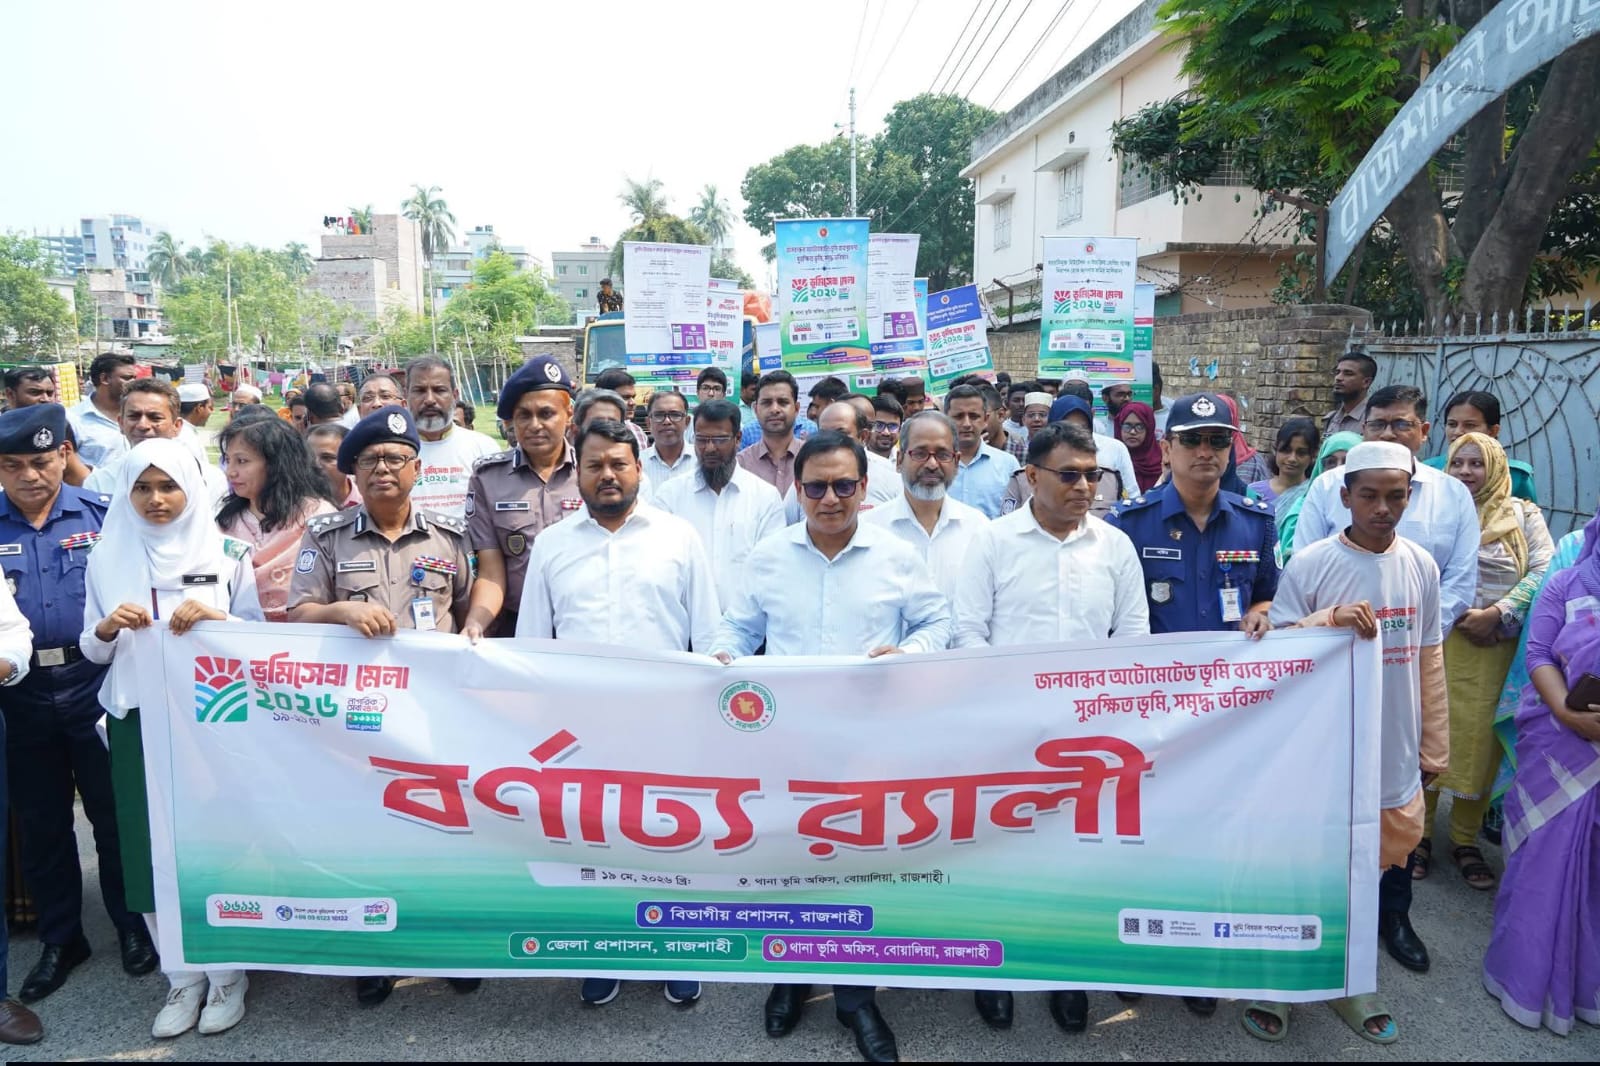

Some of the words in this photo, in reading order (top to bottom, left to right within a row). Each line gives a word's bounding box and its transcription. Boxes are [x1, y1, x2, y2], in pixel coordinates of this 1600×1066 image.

[810, 288, 837, 297] ২০২৬
[1073, 287, 1103, 301] ভূমিসেবা
[1105, 289, 1123, 300] মেলা
[1072, 300, 1102, 309] ২০২৬
[249, 652, 348, 689] ভূমিসেবা
[356, 664, 409, 691] মেলা
[1034, 670, 1106, 690] জনবান্ধব
[1109, 661, 1196, 686] অটোমেটেড
[1199, 658, 1230, 688] ভূমি
[255, 688, 339, 718] ২০২৬
[1073, 693, 1133, 722] সুরক্ষিত
[1137, 690, 1170, 719] ভূমি,
[1173, 691, 1215, 717] সমৃদ্ধ
[368, 729, 761, 851] বর্ণাঢ্য
[602, 870, 617, 880] ১৯
[620, 872, 637, 883] মে,
[641, 875, 673, 884] ২০২৬
[754, 877, 777, 886] থানা
[781, 876, 801, 887] ভূমি
[804, 875, 840, 885] অফিস,
[223, 900, 261, 912] ১৬১২২
[669, 906, 730, 924] বিভাগীয়
[735, 906, 793, 925] প্রশাসন,
[800, 907, 862, 926] রাজশাহী
[546, 937, 589, 952] জেলা
[594, 937, 657, 955] প্রশাসন,
[665, 936, 732, 954] রাজশাহী
[789, 941, 813, 955] থানা
[816, 940, 838, 958] ভূমি
[843, 940, 879, 958] অফিস,
[884, 941, 939, 959] বোয়ালিয়া,
[944, 943, 989, 961] রাজশাহী
